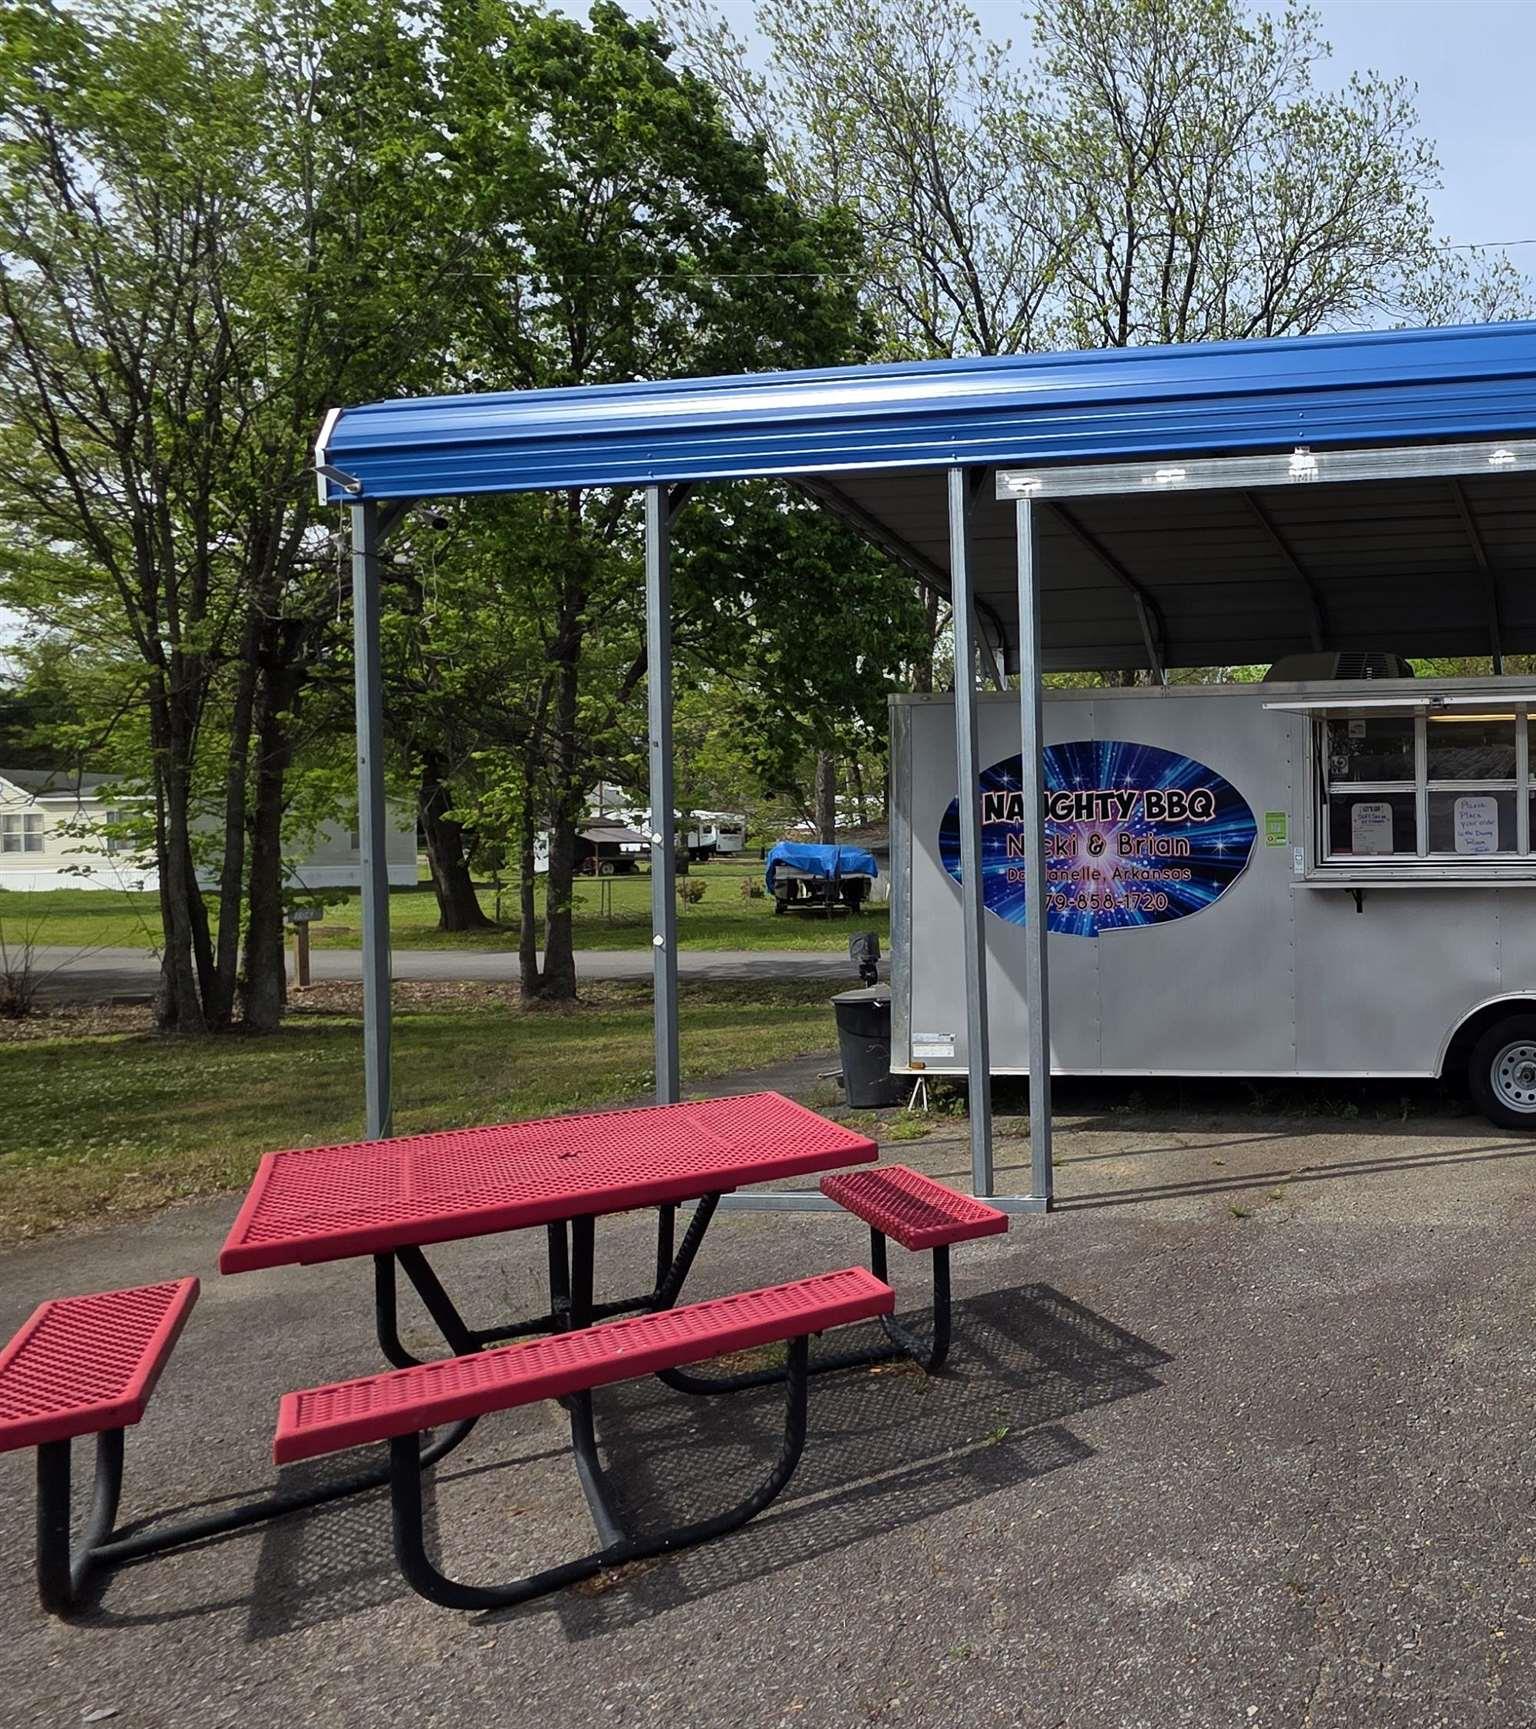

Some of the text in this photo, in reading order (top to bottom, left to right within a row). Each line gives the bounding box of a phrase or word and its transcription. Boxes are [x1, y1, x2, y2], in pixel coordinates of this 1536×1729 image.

[1144, 788, 1217, 823] BBQ
[1007, 831, 1192, 858] Ncki & Brian
[1111, 867, 1192, 882] Arkansas
[1045, 891, 1169, 912] 79-858-1720
